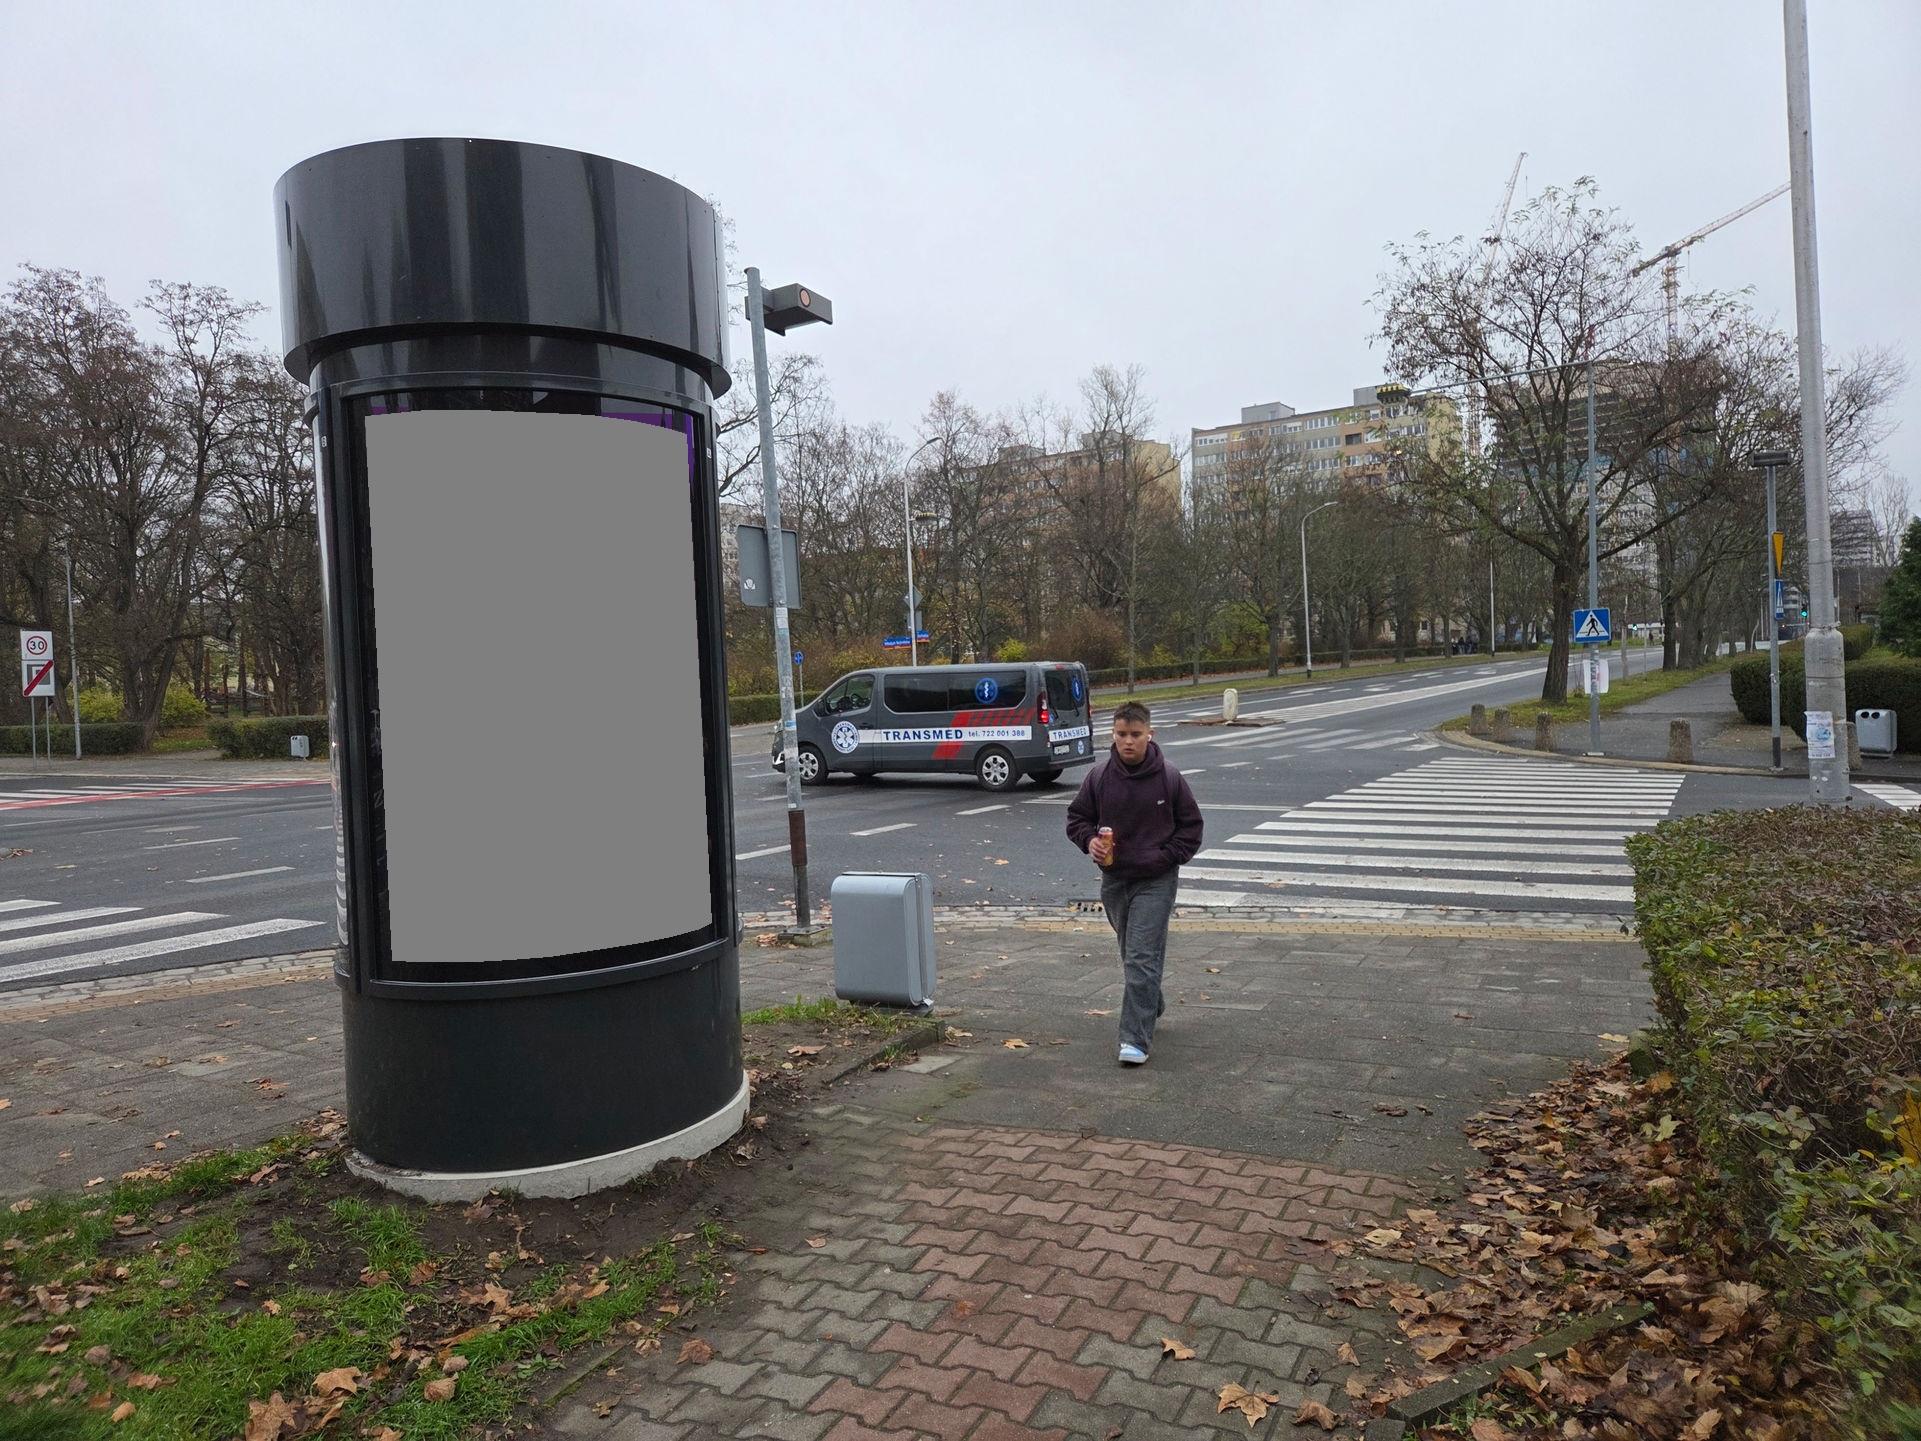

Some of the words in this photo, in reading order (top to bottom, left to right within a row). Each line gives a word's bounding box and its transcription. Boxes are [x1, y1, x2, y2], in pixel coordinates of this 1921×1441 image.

[30, 641, 44, 650] 30
[883, 729, 963, 741] TRANSMED
[1053, 728, 1087, 740] TRANSMED
